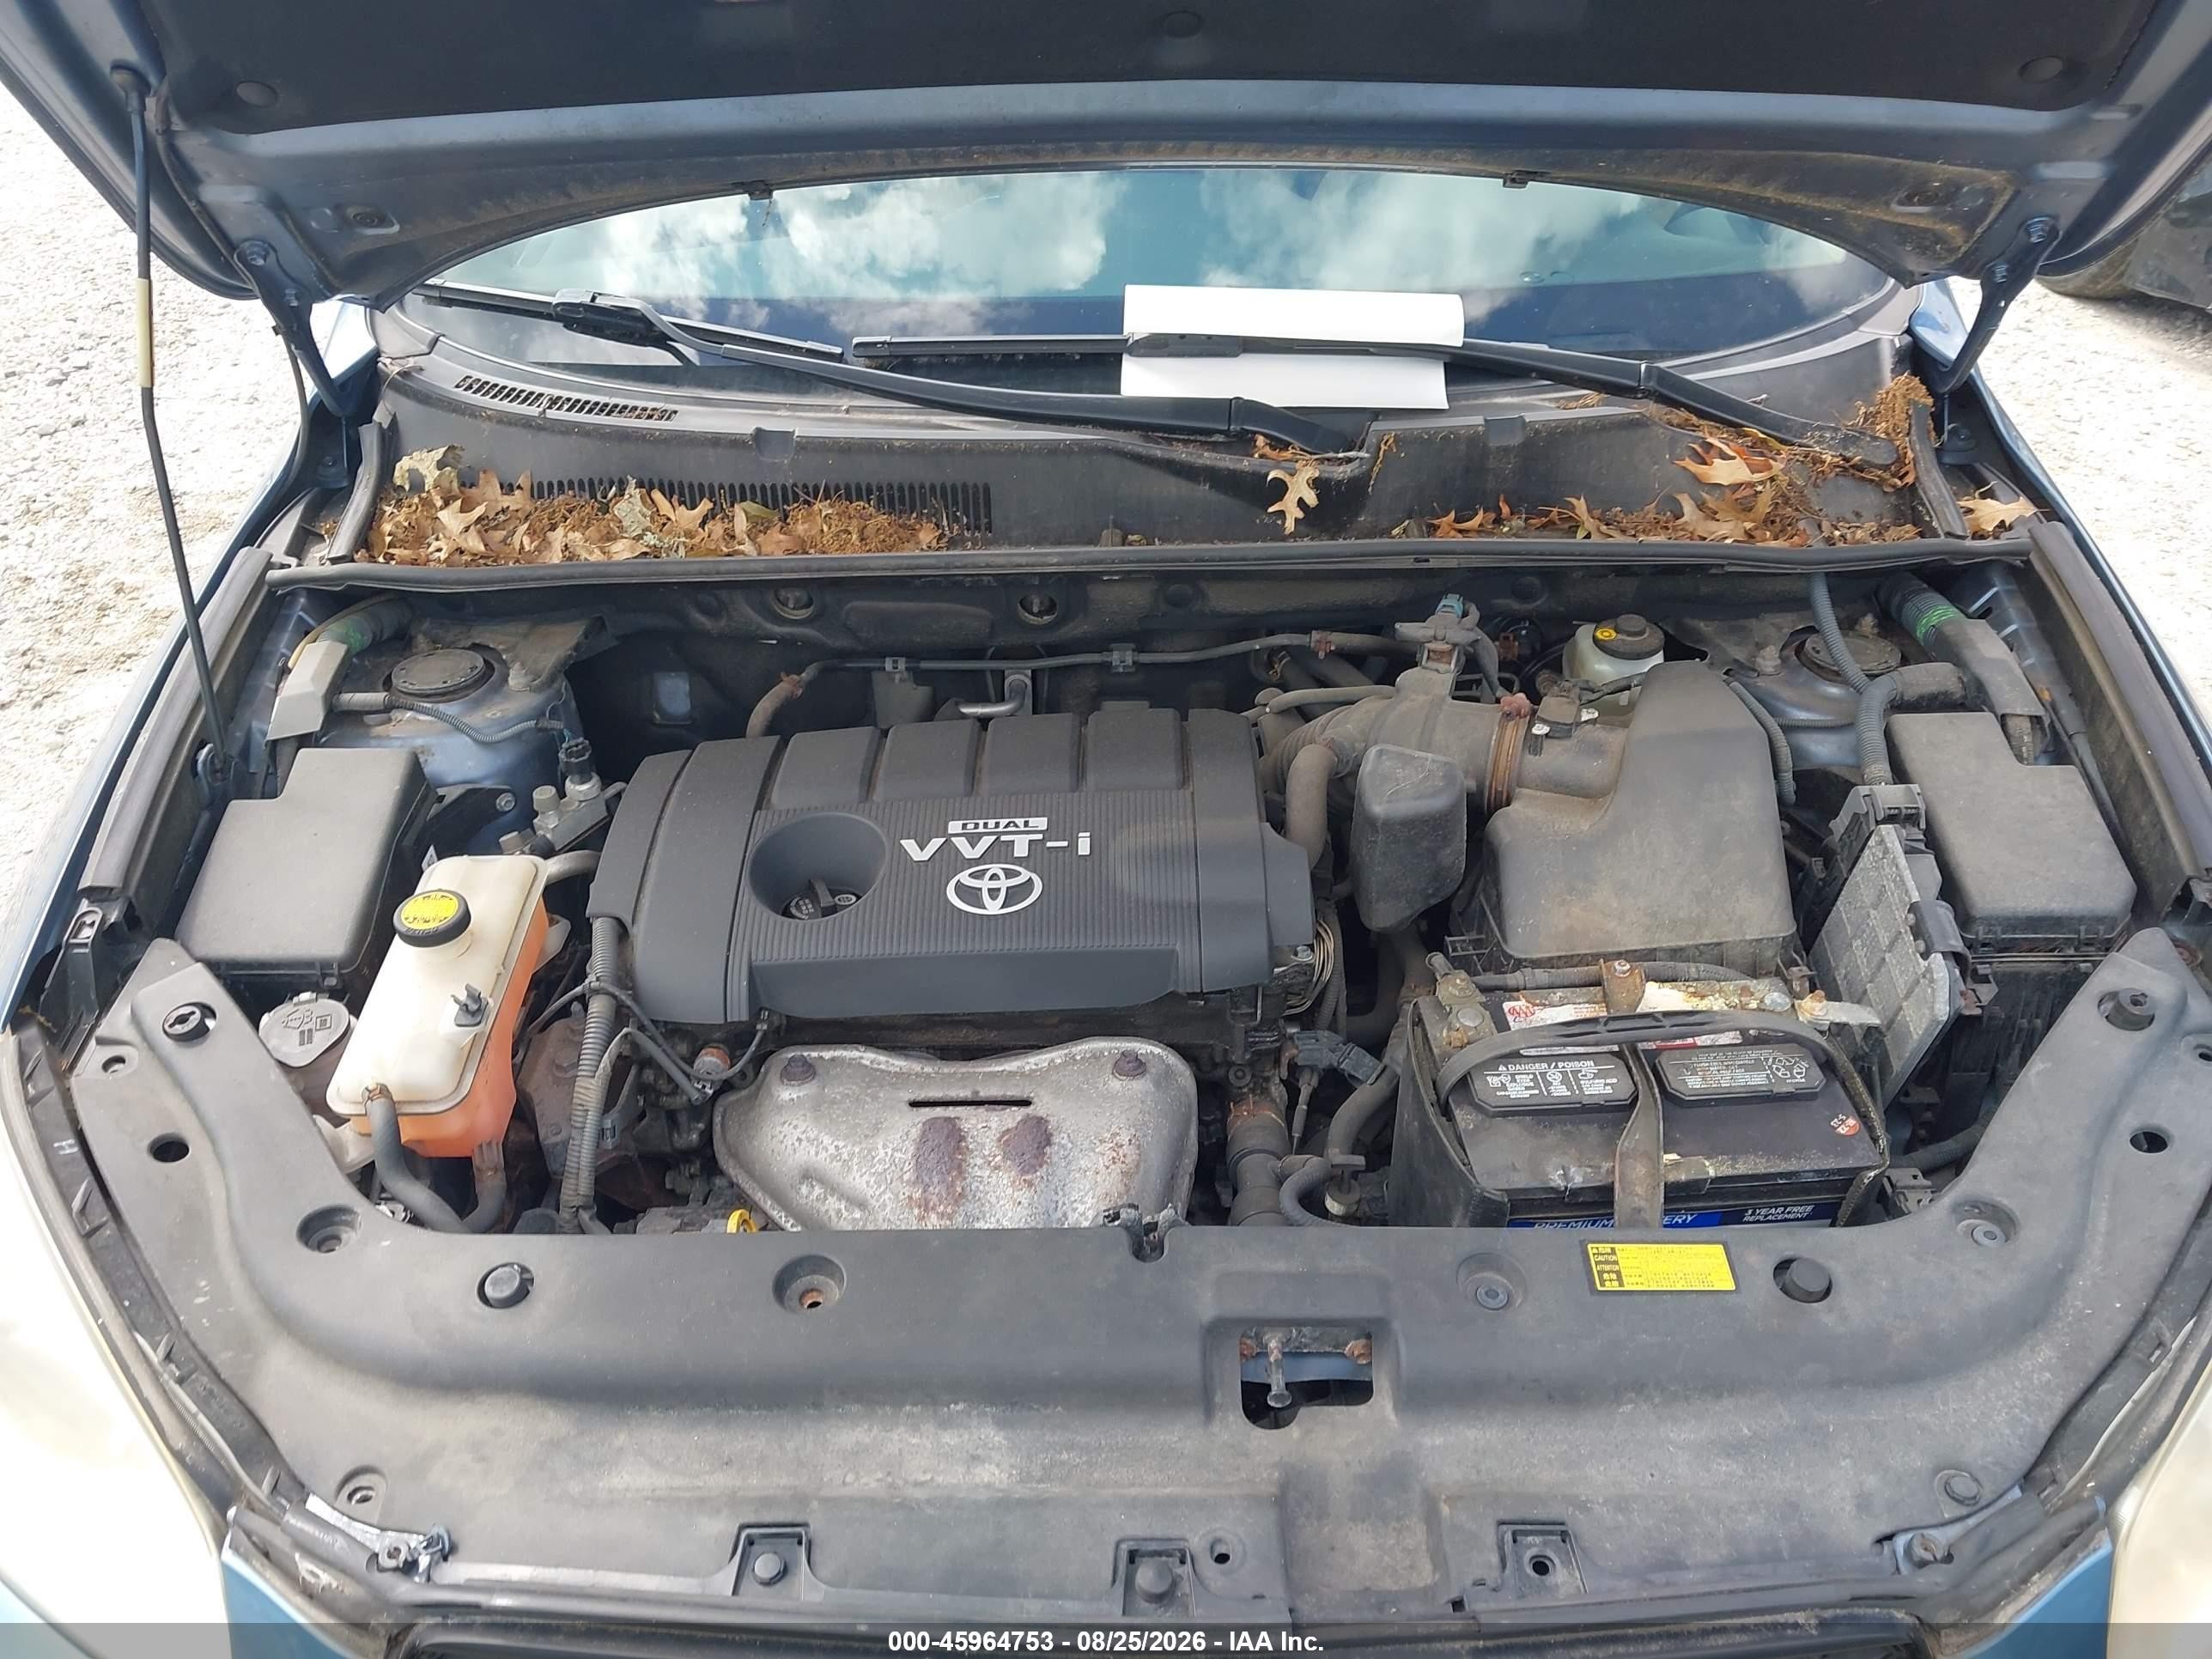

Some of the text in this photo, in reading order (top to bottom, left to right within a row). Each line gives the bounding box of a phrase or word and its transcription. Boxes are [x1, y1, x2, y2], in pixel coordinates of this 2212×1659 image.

[961, 819, 1039, 831] DUAL
[899, 831, 1091, 862] VVT-i
[1508, 1062, 1548, 1071] DANGER
[1558, 1060, 1595, 1068] POISON
[1754, 1206, 1784, 1215] YEAR
[1784, 1205, 1815, 1213] FREE
[1662, 1213, 1697, 1224] ERY
[1742, 1212, 1809, 1222] REPLACEMENT
